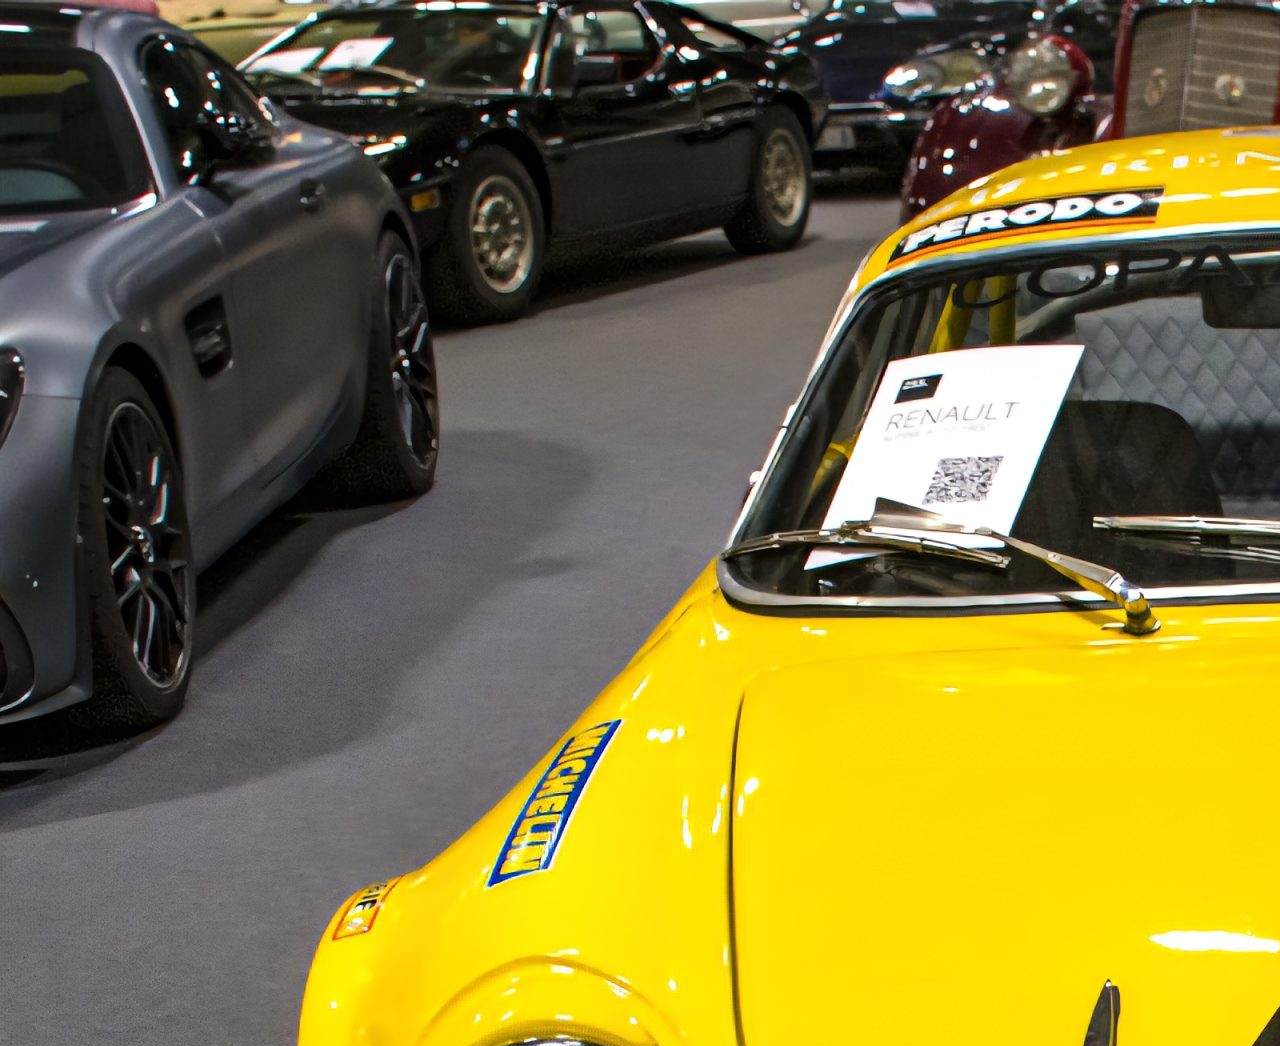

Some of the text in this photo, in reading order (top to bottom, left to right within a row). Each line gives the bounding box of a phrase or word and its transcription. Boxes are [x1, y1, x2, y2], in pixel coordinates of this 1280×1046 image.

[901, 192, 1143, 253] FERODO
[952, 245, 1250, 309] COPA
[886, 402, 1021, 432] RENAULT
[499, 723, 612, 875] MICHELIN
